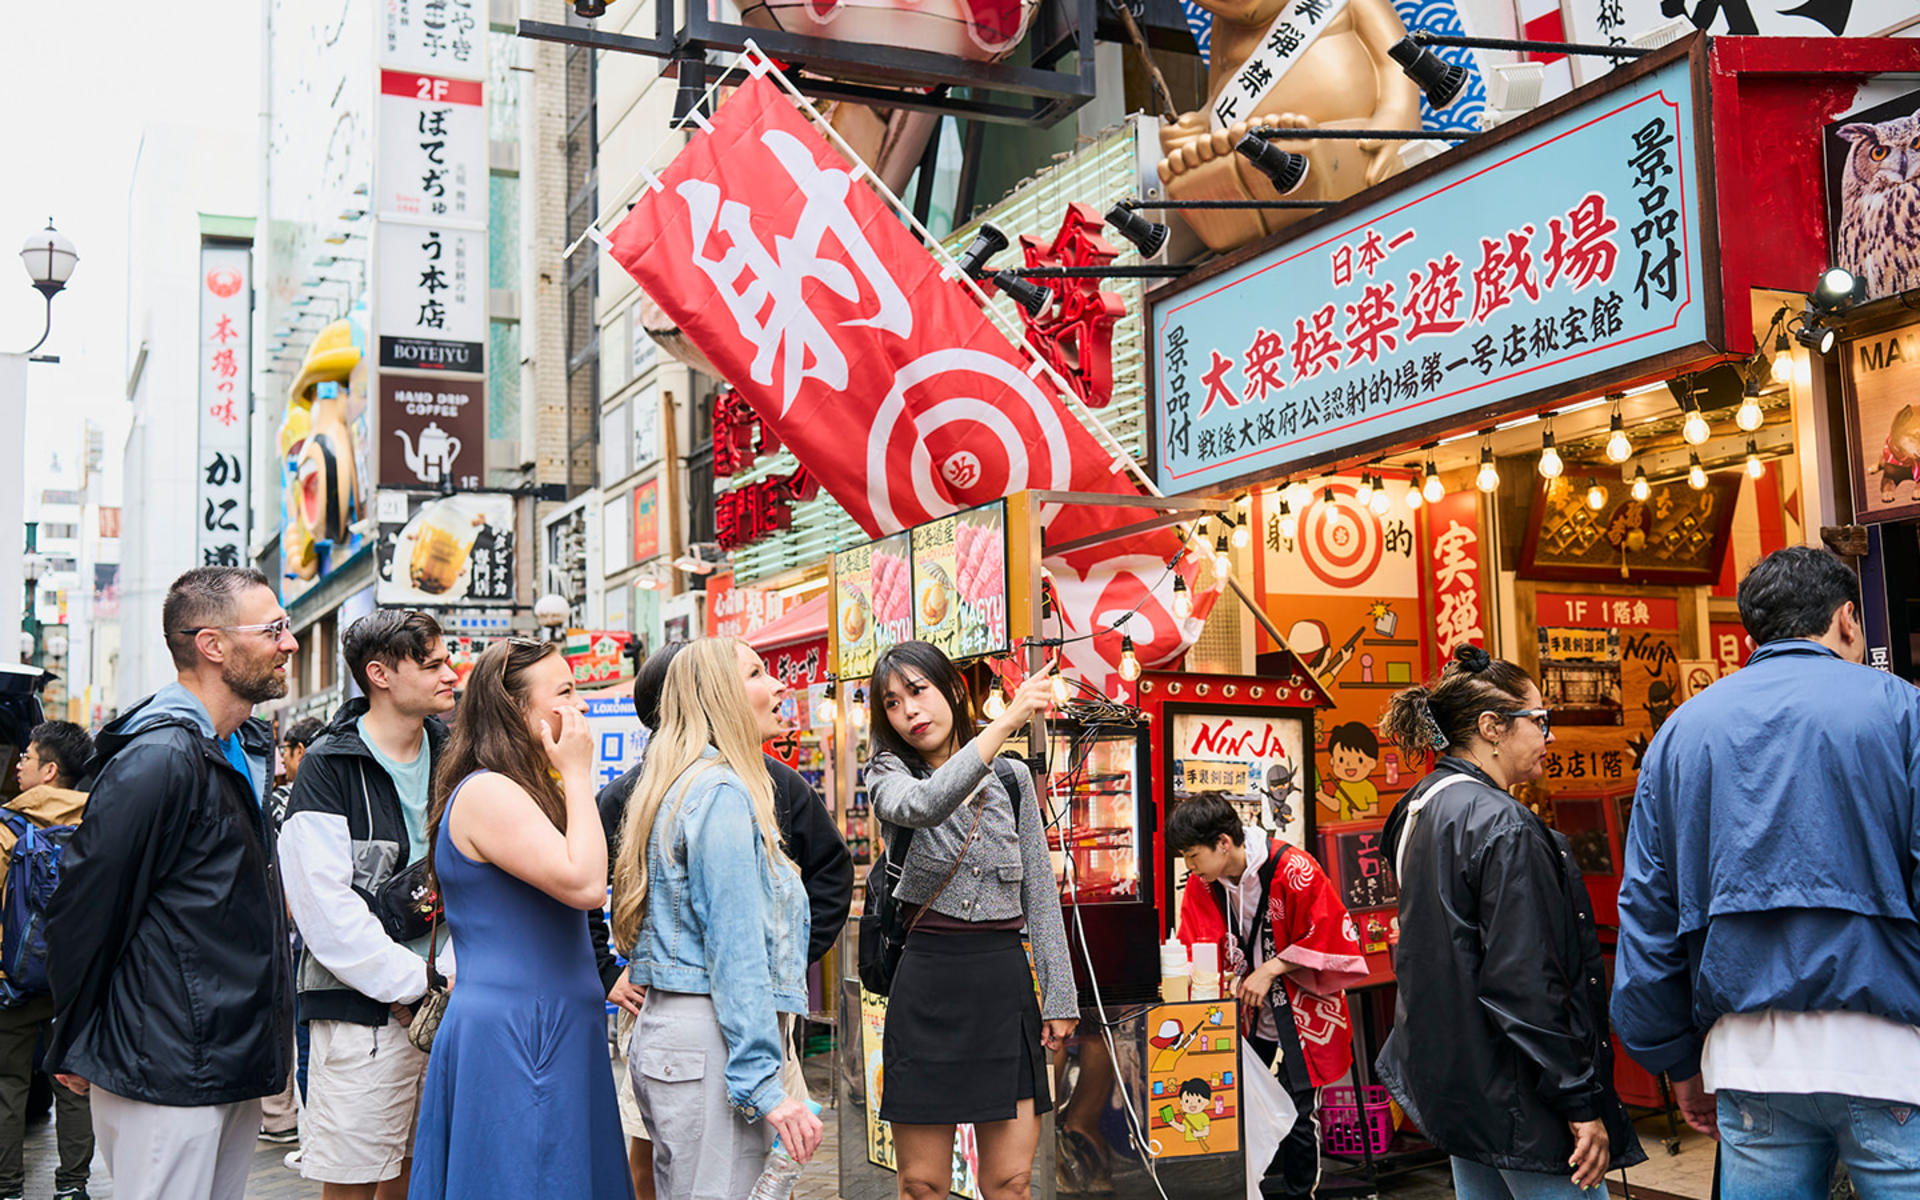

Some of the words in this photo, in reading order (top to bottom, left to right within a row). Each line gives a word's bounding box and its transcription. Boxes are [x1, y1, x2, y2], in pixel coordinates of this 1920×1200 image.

[416, 78, 448, 100] 2F
[1628, 117, 1681, 310] 景品付
[676, 129, 914, 420] 射
[1332, 229, 1417, 287] 日本一
[1197, 193, 1618, 420] 大衆娯楽遊戯場
[394, 344, 470, 364] BOTEJYU
[394, 390, 434, 404] HAND
[436, 393, 470, 406] DRIP
[405, 403, 459, 418] COFFEE
[1165, 325, 1192, 461] 景品付
[1384, 519, 1412, 559] 的
[959, 594, 1003, 627] WAGYU
[1565, 600, 1588, 623] 1F
[1191, 719, 1286, 759] NINJA
[1545, 750, 1623, 779] 当店1階
